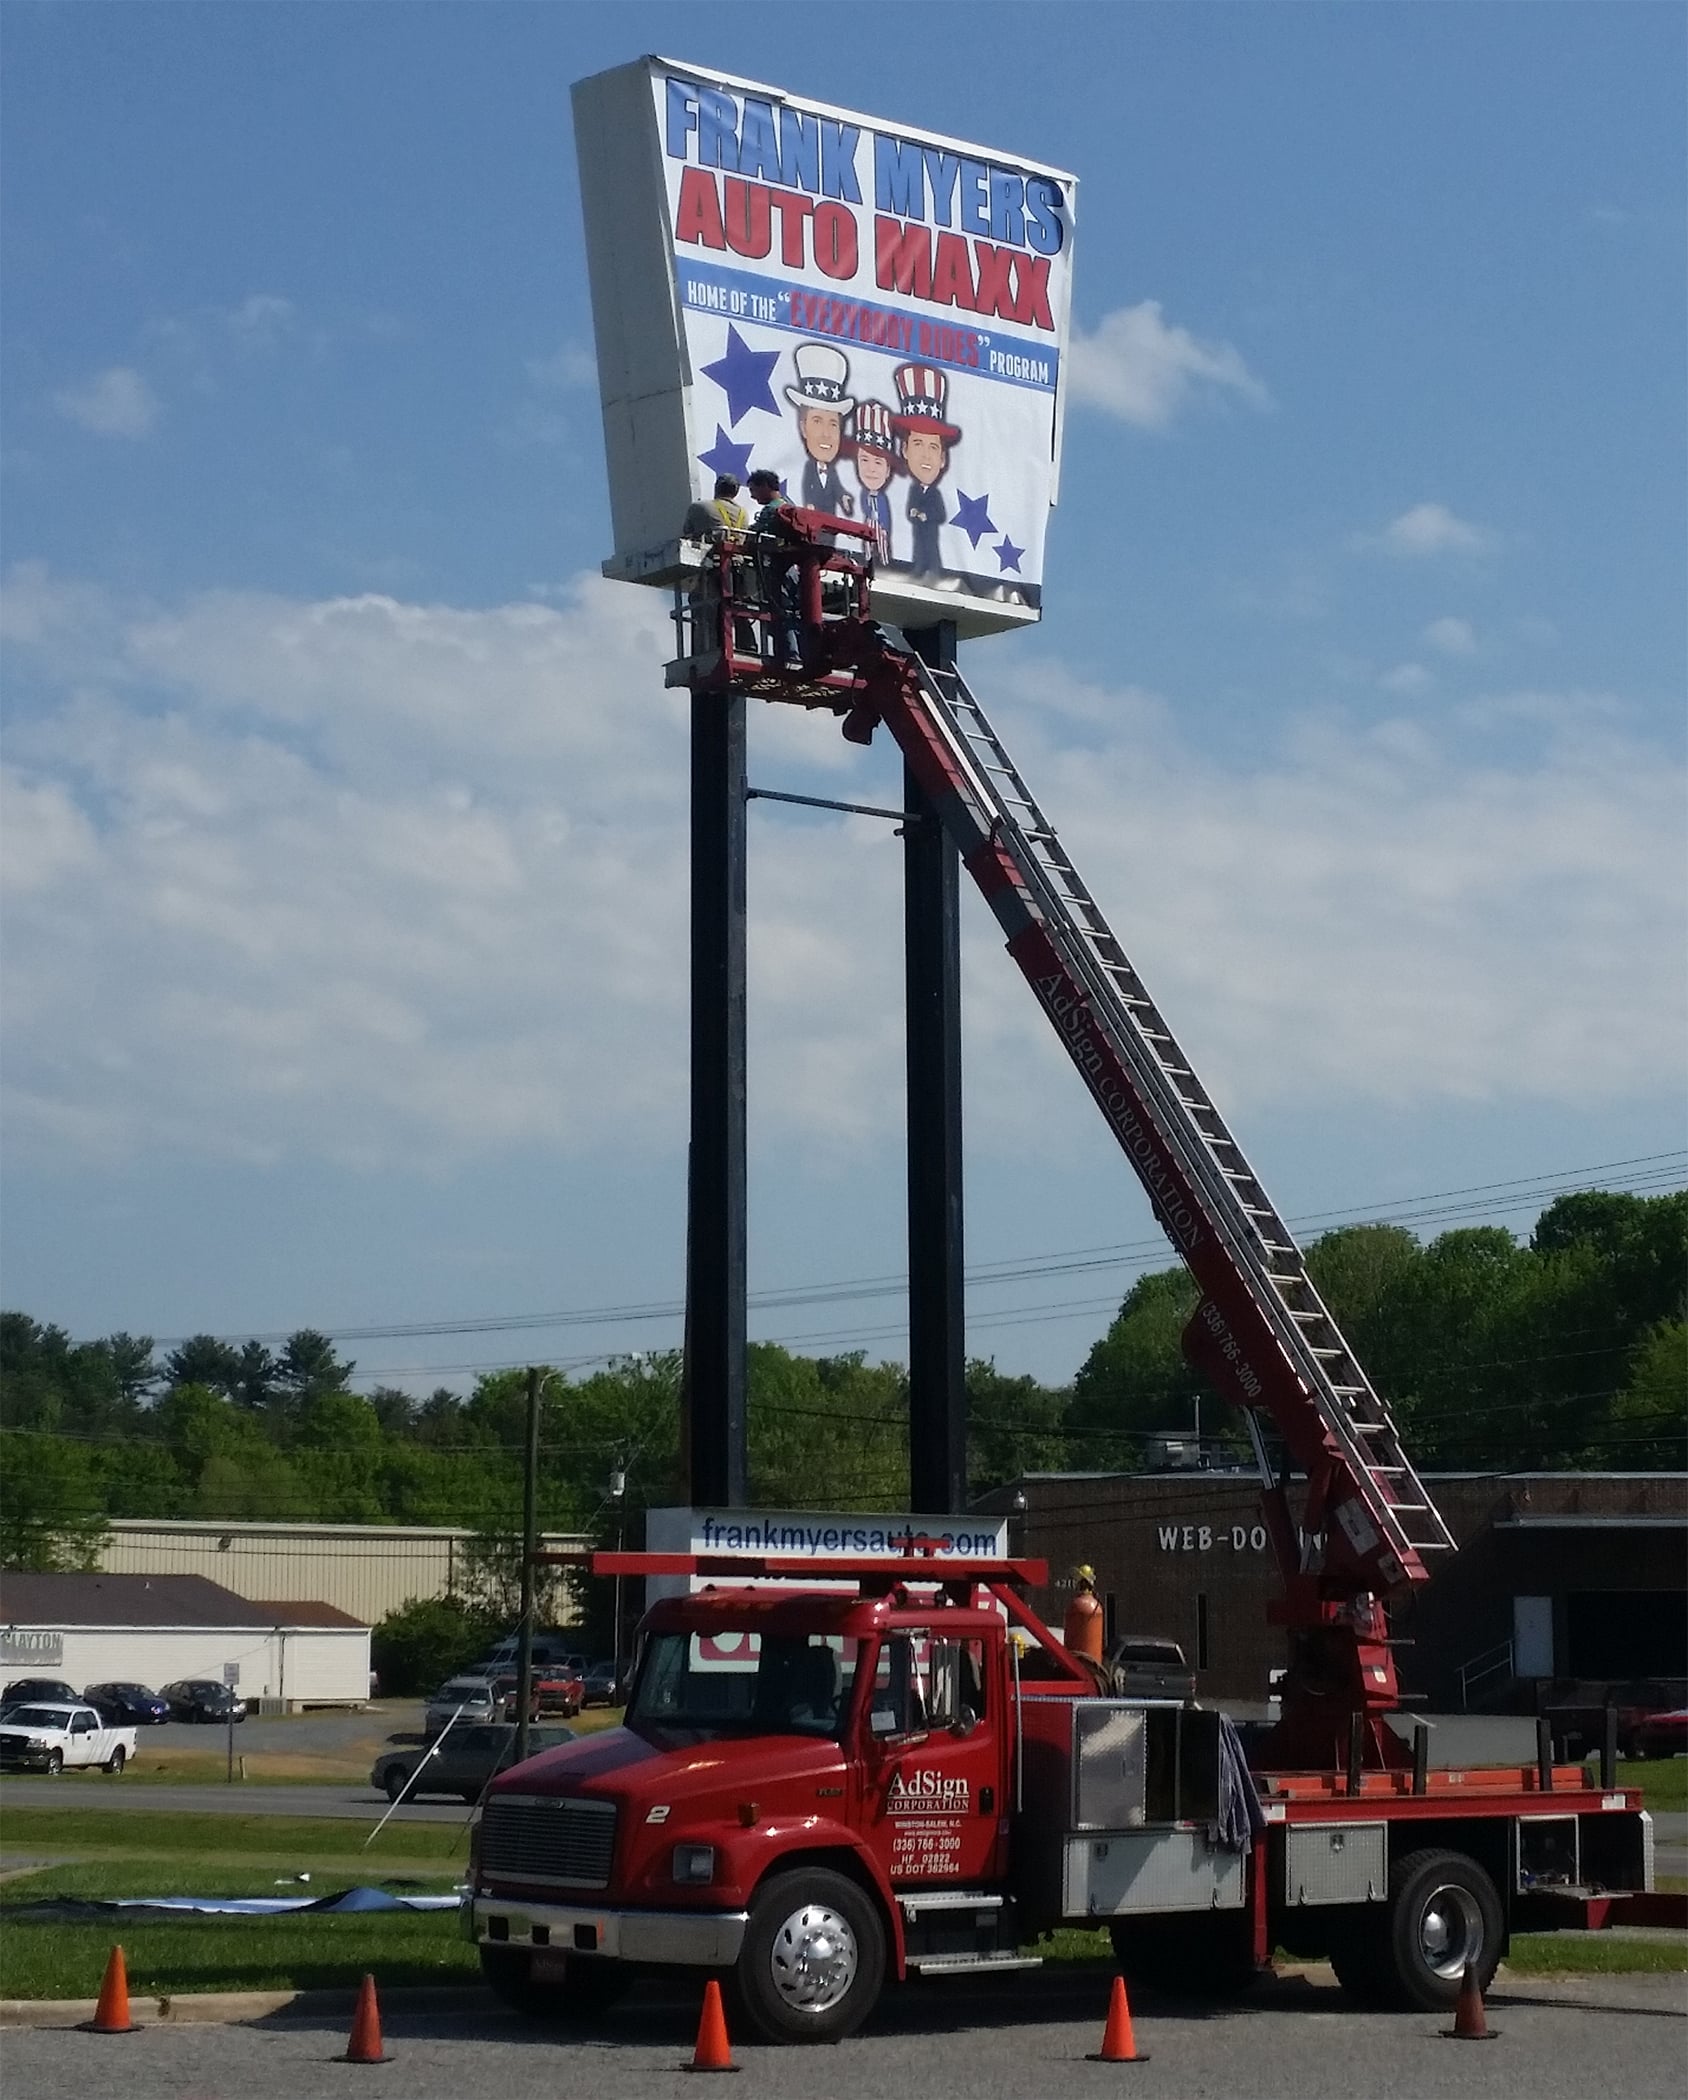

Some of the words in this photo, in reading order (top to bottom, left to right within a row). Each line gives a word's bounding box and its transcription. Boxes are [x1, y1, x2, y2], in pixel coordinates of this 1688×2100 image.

[666, 76, 863, 205] FRANK
[874, 132, 1063, 255] MYERS
[676, 165, 858, 280] AUTO
[874, 213, 1055, 332] MAXX
[687, 281, 727, 310] HOME
[730, 290, 748, 314] OF
[751, 295, 776, 321] THE
[990, 350, 1049, 384] PROGRAM
[1036, 974, 1104, 1073] AdSign
[1099, 1077, 1204, 1249] CORPORATION
[701, 1517, 997, 1556] frankmyersautcom
[1158, 1526, 1268, 1550] WEB-DO
[888, 1769, 968, 1800] AdSign
[645, 1805, 671, 1824] 2
[887, 1800, 969, 1811] CORPORATION
[905, 1863, 924, 1875] DOT
